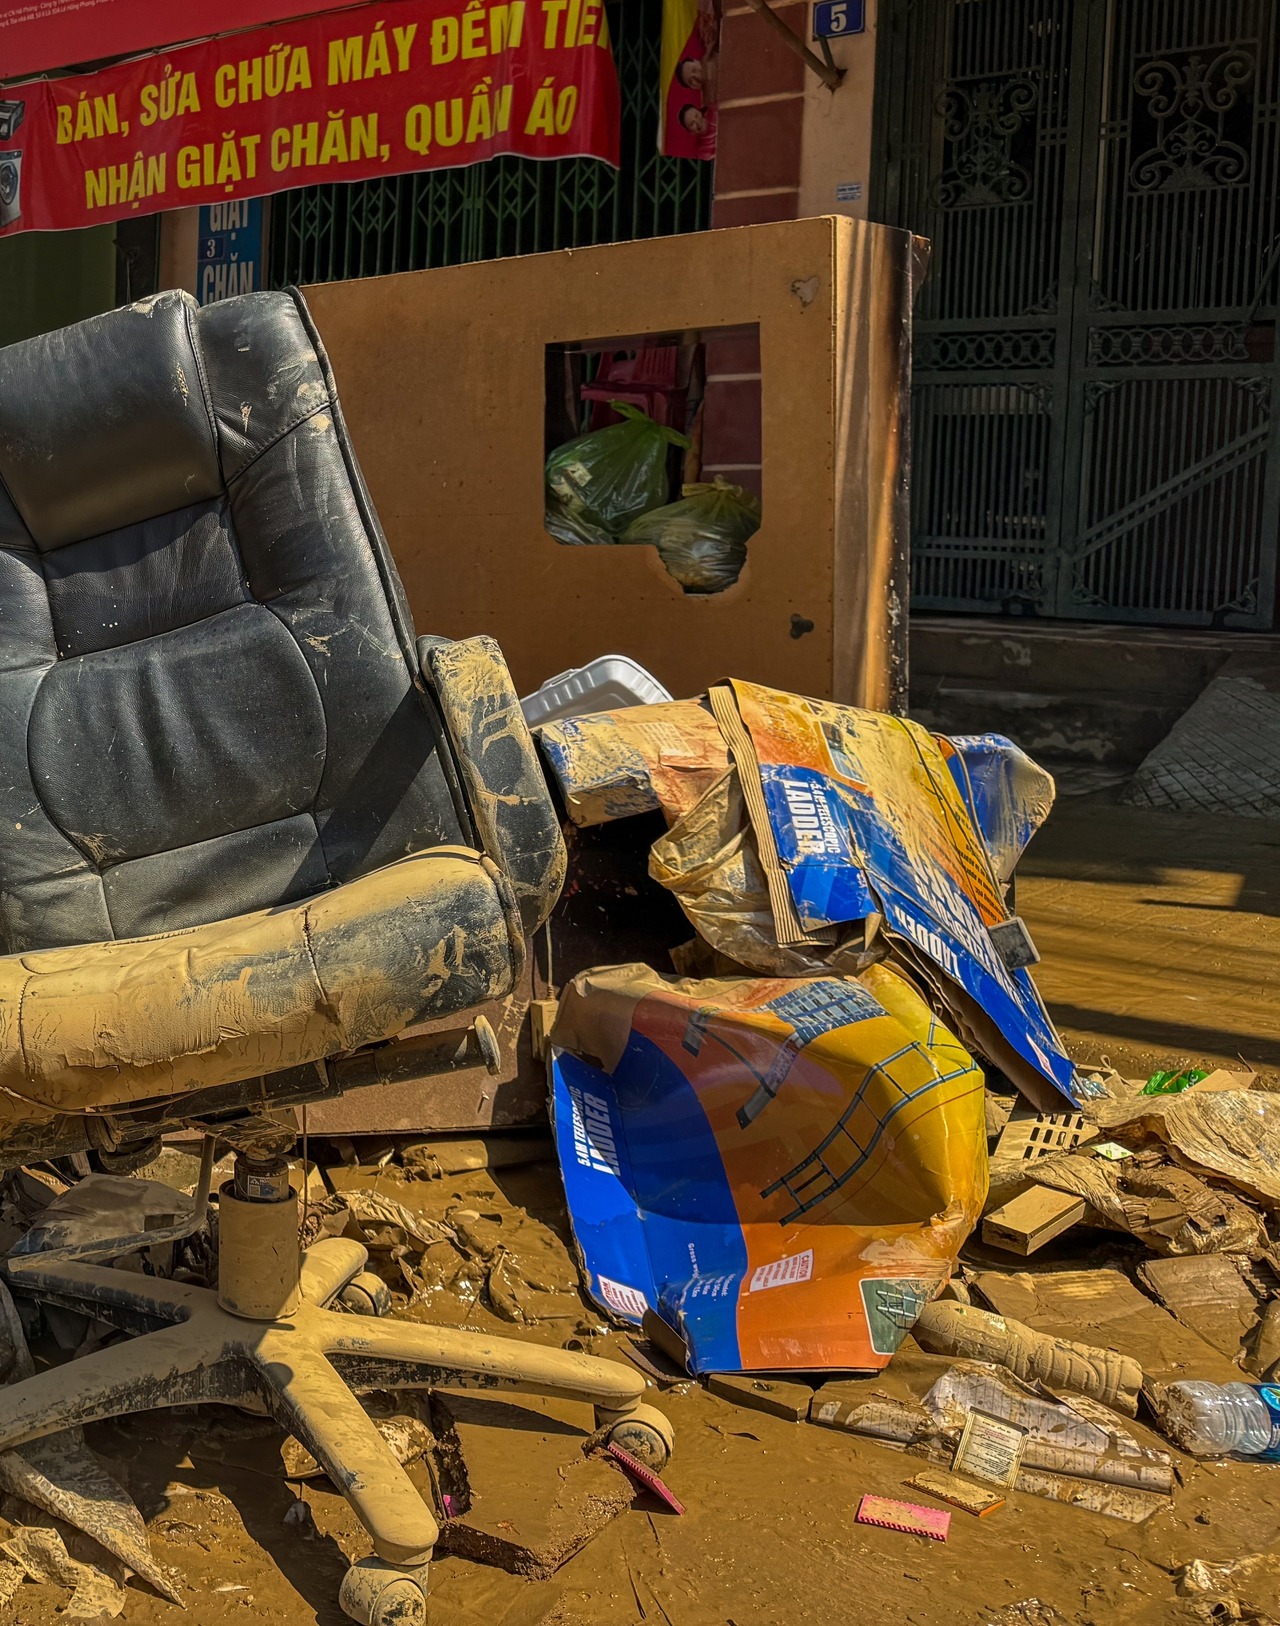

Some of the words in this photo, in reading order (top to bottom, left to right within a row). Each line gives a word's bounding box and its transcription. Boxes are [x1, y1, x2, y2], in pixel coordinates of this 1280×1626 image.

[830, 3, 847, 32] 5
[56, 91, 130, 145] BÁN,
[140, 63, 201, 127] SỬA
[215, 43, 312, 109] CHỮA
[327, 20, 418, 86] MÁY
[84, 151, 167, 210] NHẬN
[176, 130, 261, 193] GIẶT
[271, 109, 390, 172] CHĂN,
[404, 76, 514, 156] QUẦN
[524, 76, 578, 137] ÁO
[202, 252, 254, 305] CHĂN
[206, 240, 216, 258] 3
[782, 780, 826, 854] LADDER
[568, 1085, 586, 1144] TELESCOPIC
[583, 1092, 622, 1177] LADDER
